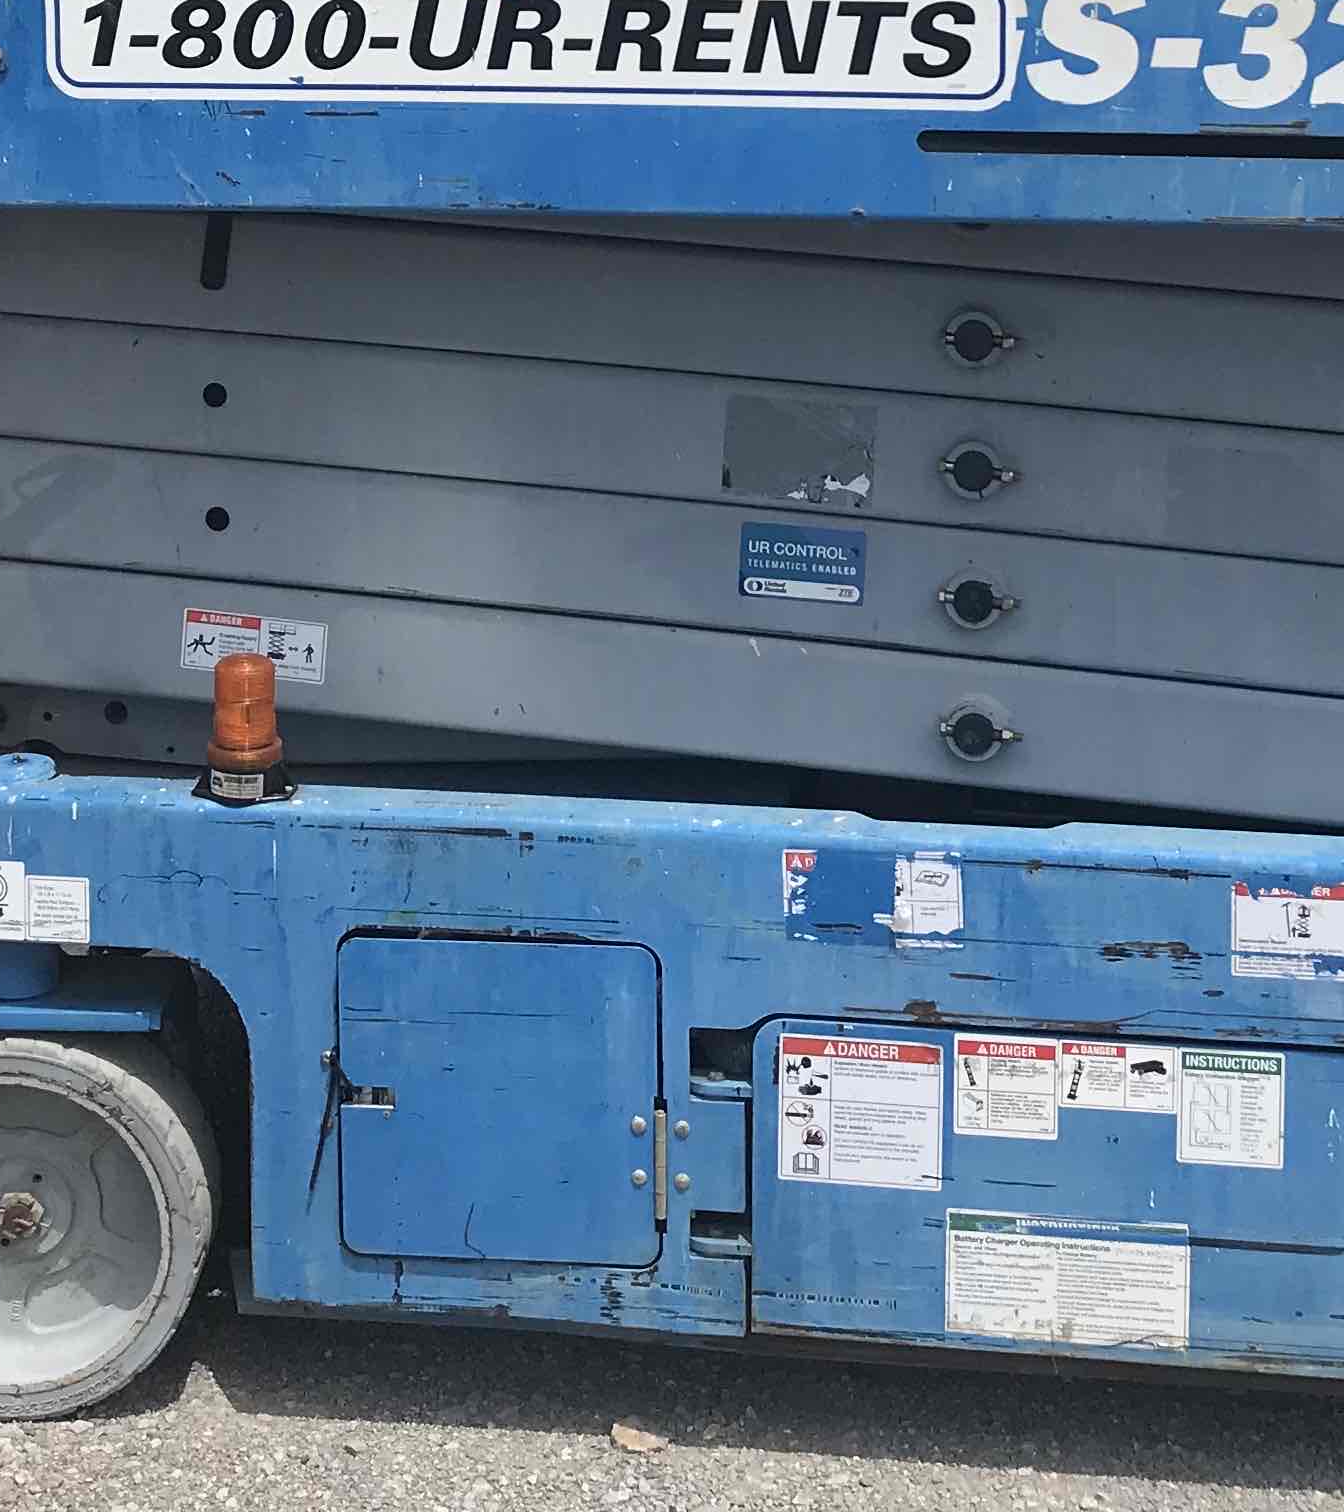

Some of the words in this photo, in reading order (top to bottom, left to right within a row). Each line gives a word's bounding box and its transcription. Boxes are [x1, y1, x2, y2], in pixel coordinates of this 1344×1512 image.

[748, 539, 770, 554] UR
[773, 542, 848, 561] CONTROL
[747, 558, 808, 571] TELEMATICS
[812, 563, 857, 576] ENABLED
[209, 614, 243, 627] DANGER
[838, 1042, 900, 1060] DANGER
[990, 1044, 1037, 1059] DANGER
[1080, 1044, 1118, 1057] DANGER
[1184, 1054, 1278, 1072] INSTRUCTIONS
[954, 1234, 984, 1244] Battery
[985, 1236, 1018, 1247] Charger
[1019, 1239, 1061, 1249] Operating
[1061, 1241, 1111, 1253] Instructions
